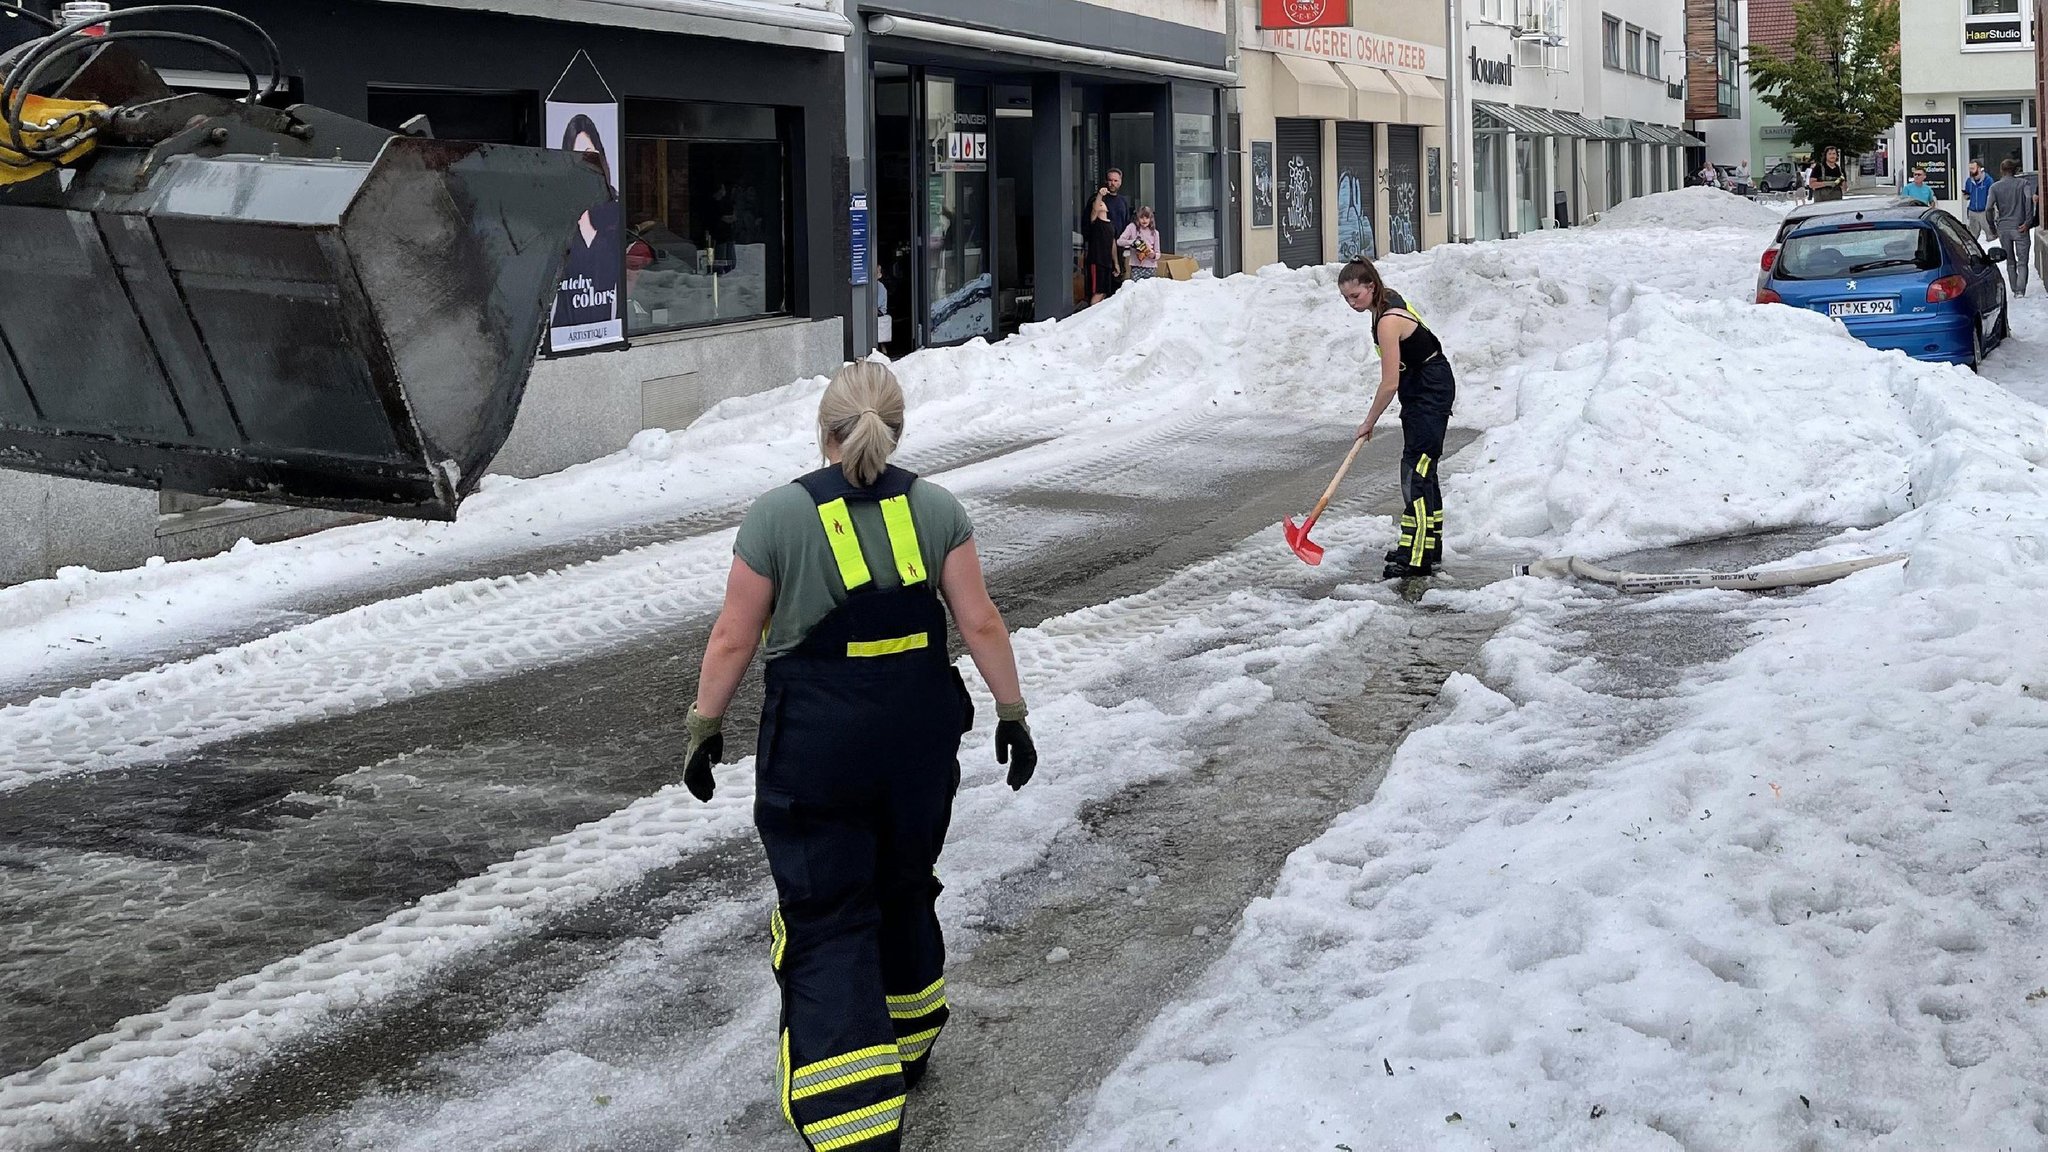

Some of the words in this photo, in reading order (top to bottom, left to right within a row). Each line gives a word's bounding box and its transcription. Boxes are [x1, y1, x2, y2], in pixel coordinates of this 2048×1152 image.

[1966, 29, 2020, 40] HaarStudio
[1357, 35, 1394, 65] OSKAR
[1398, 44, 1425, 70] ZEEB
[1911, 129, 1936, 143] cut
[1911, 139, 1951, 155] walk
[572, 286, 616, 309] colors
[1829, 303, 1844, 315] RT
[1853, 302, 1867, 314] XE
[1870, 301, 1893, 313] 994
[568, 327, 608, 341] ARTISTIQUE
